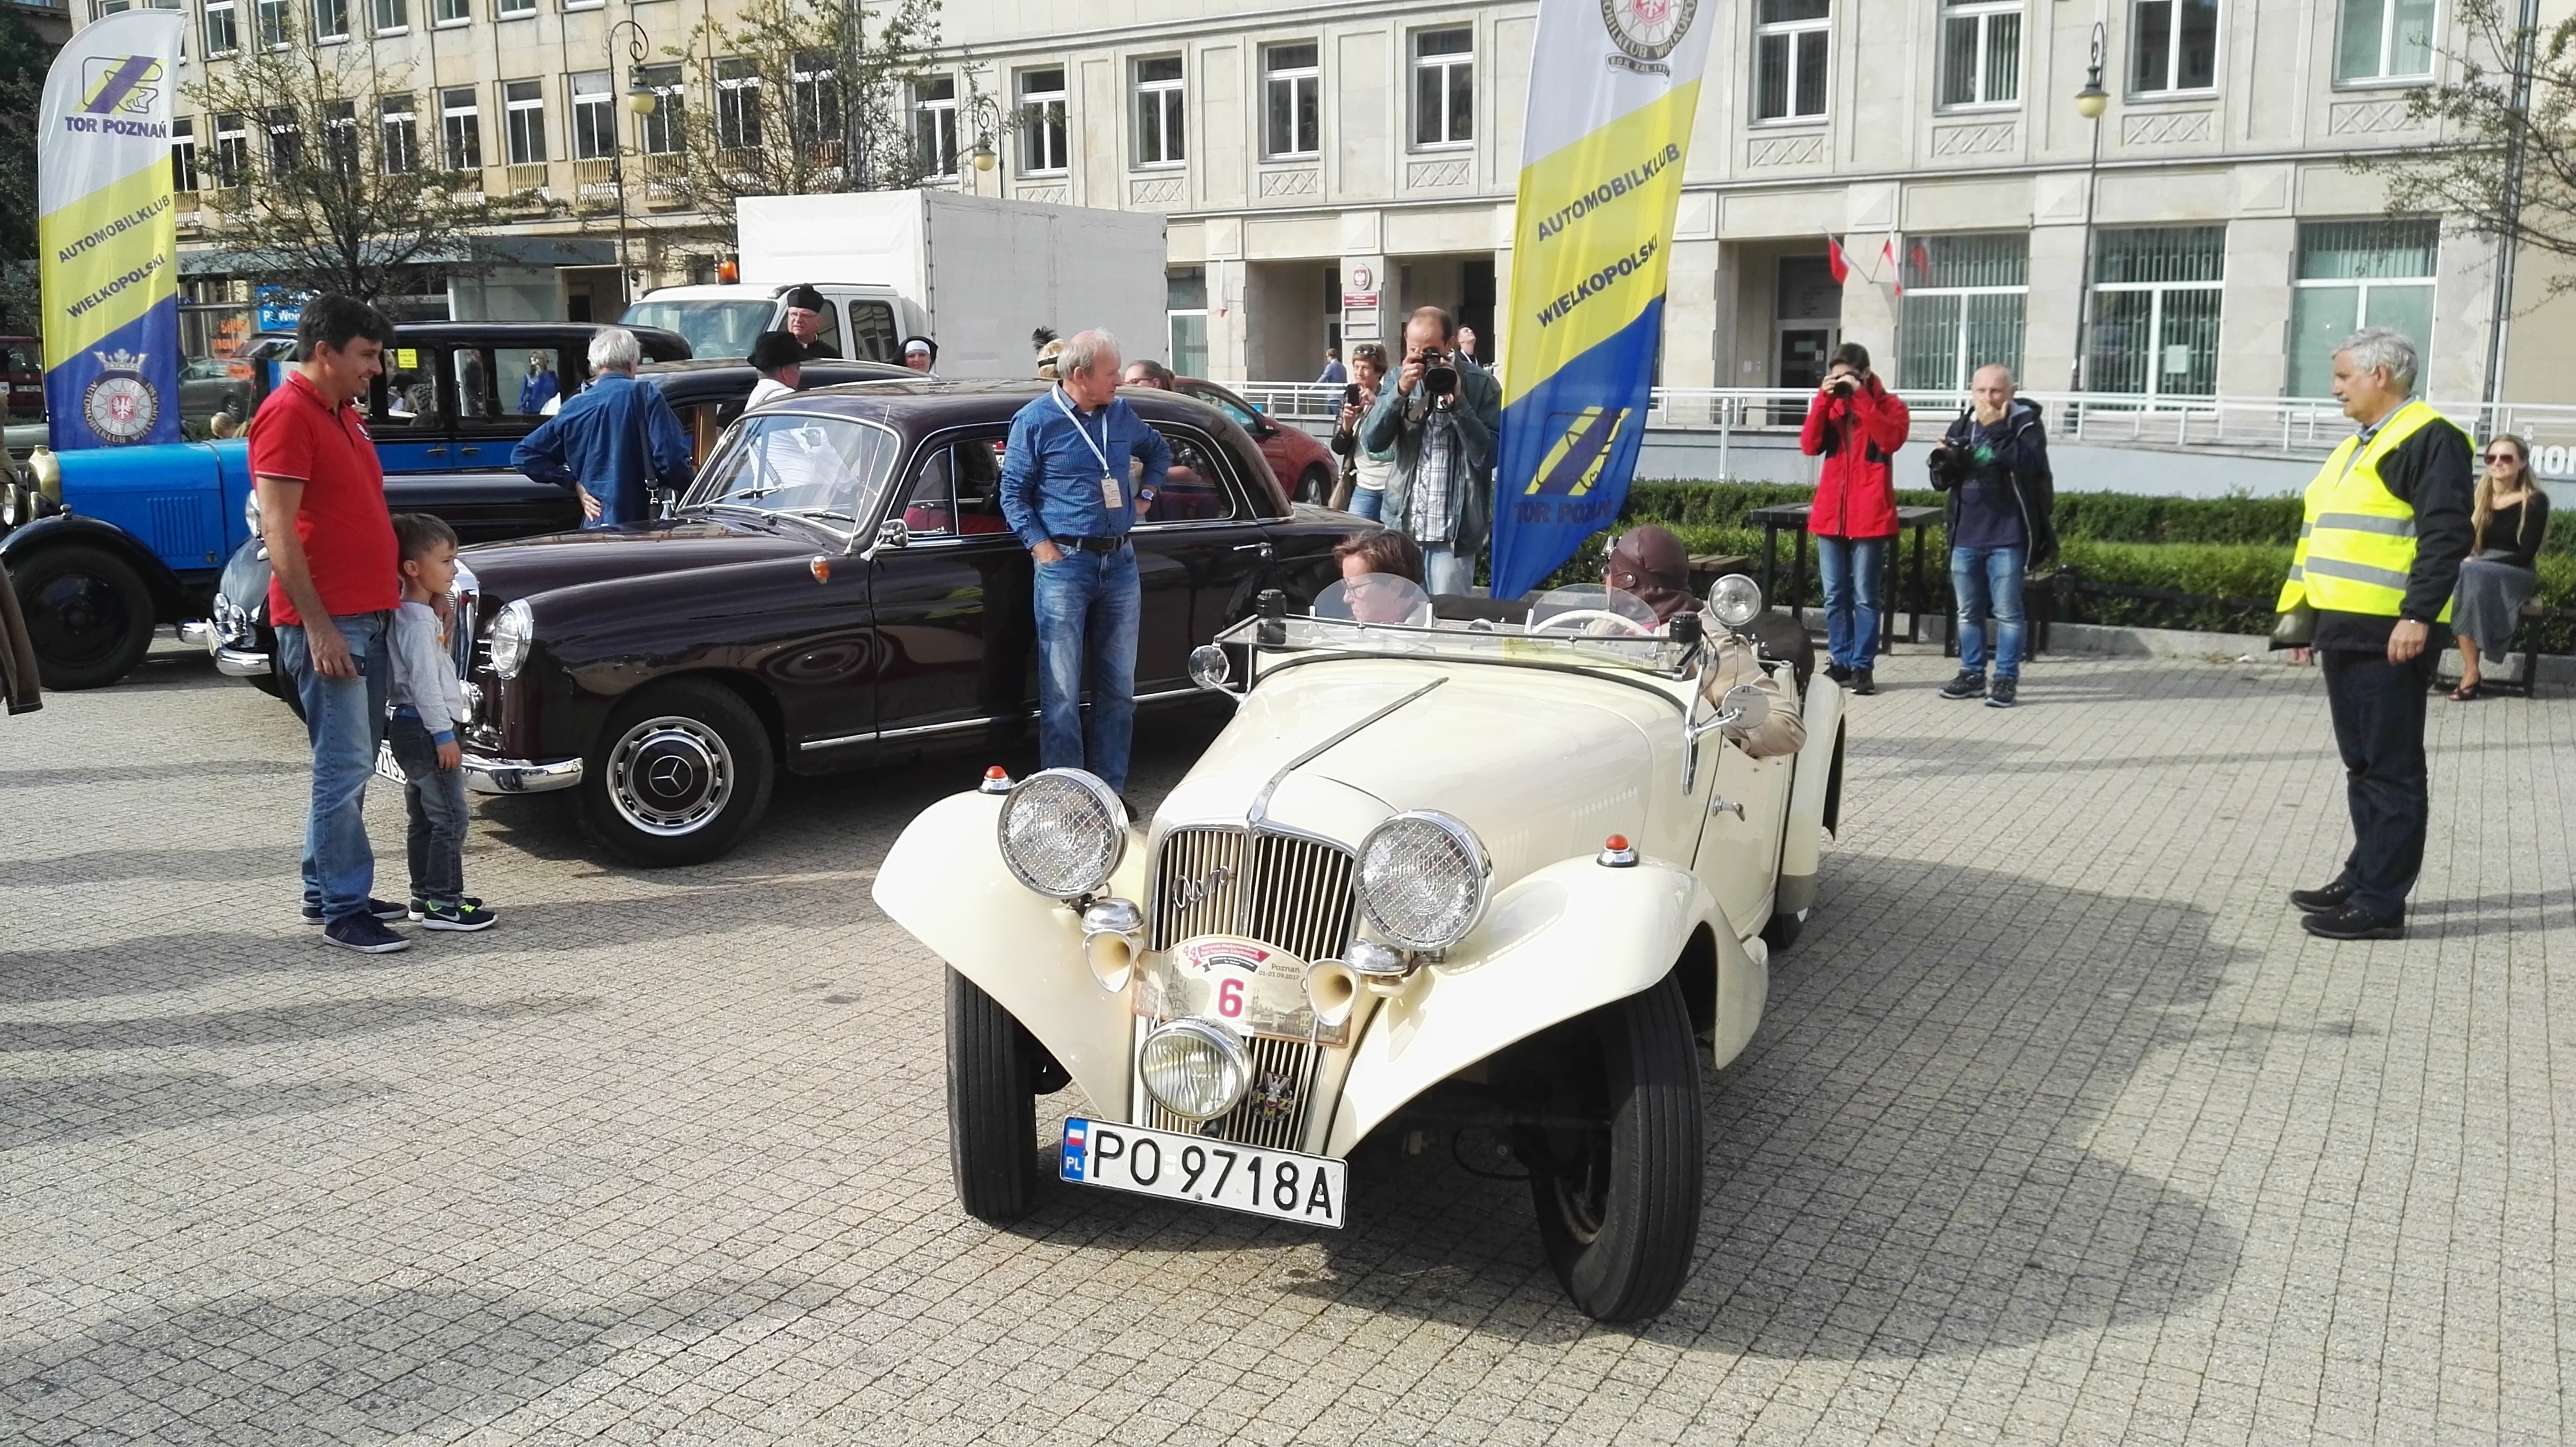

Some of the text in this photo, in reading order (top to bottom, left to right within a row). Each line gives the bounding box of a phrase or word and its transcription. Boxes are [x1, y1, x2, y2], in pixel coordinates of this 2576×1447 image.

[65, 116, 167, 139] TOR POZNAŃ
[1538, 142, 1681, 242] AUTOMOBILKLUB
[58, 195, 170, 263] AUTOMOBILKLUB
[66, 253, 165, 318] WIELKOPOLSKI
[1536, 234, 1658, 328] WIELKOPOLSKI
[1515, 501, 1551, 523] TOR
[1172, 865, 1237, 911] Aero
[1259, 970, 1299, 979] 01-03.09.2017
[1271, 963, 1300, 973] Poznań
[1218, 977, 1245, 1018] 6
[1066, 1156, 1081, 1171] PL
[1092, 1129, 1333, 1218] PO 9718A
